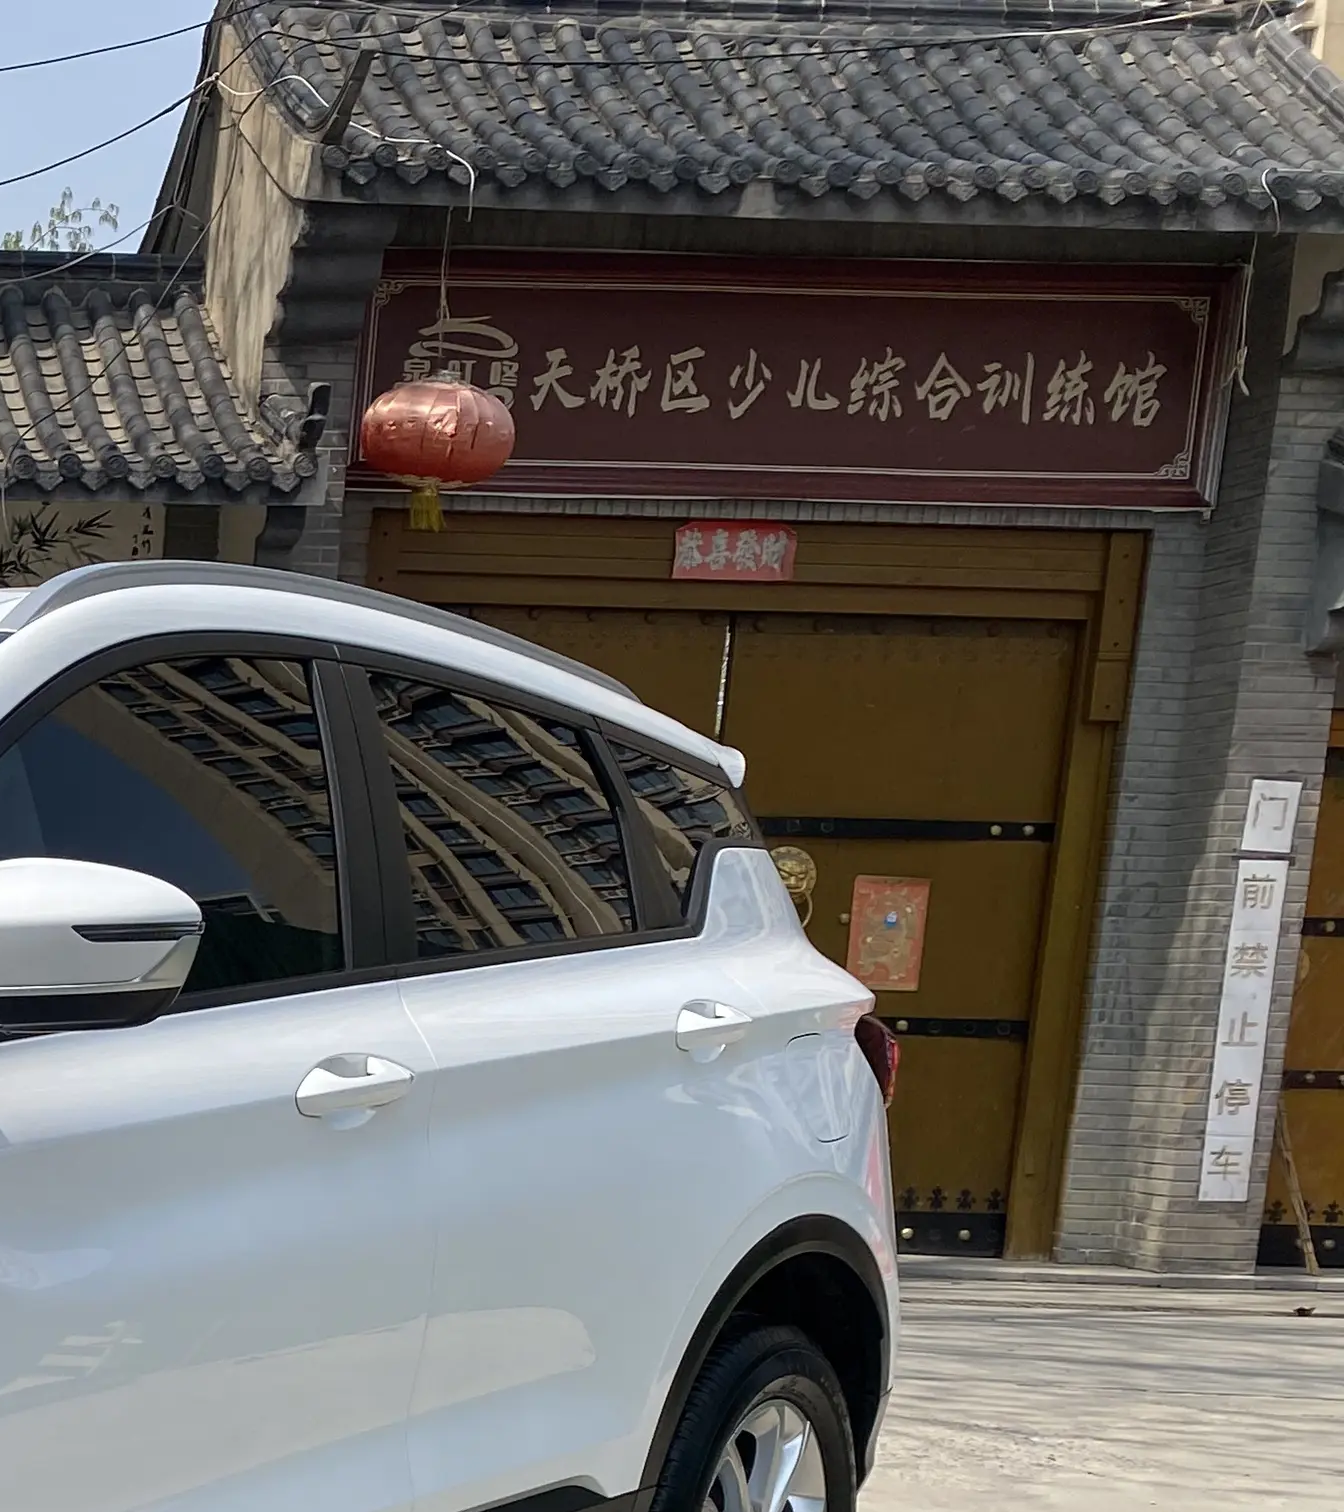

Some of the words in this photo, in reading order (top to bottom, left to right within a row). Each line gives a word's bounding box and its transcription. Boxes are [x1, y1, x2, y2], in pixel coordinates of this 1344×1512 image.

[529, 344, 1168, 428] 天桥区少儿综合训练馆
[1206, 792, 1290, 1182] 门前禁止停车
